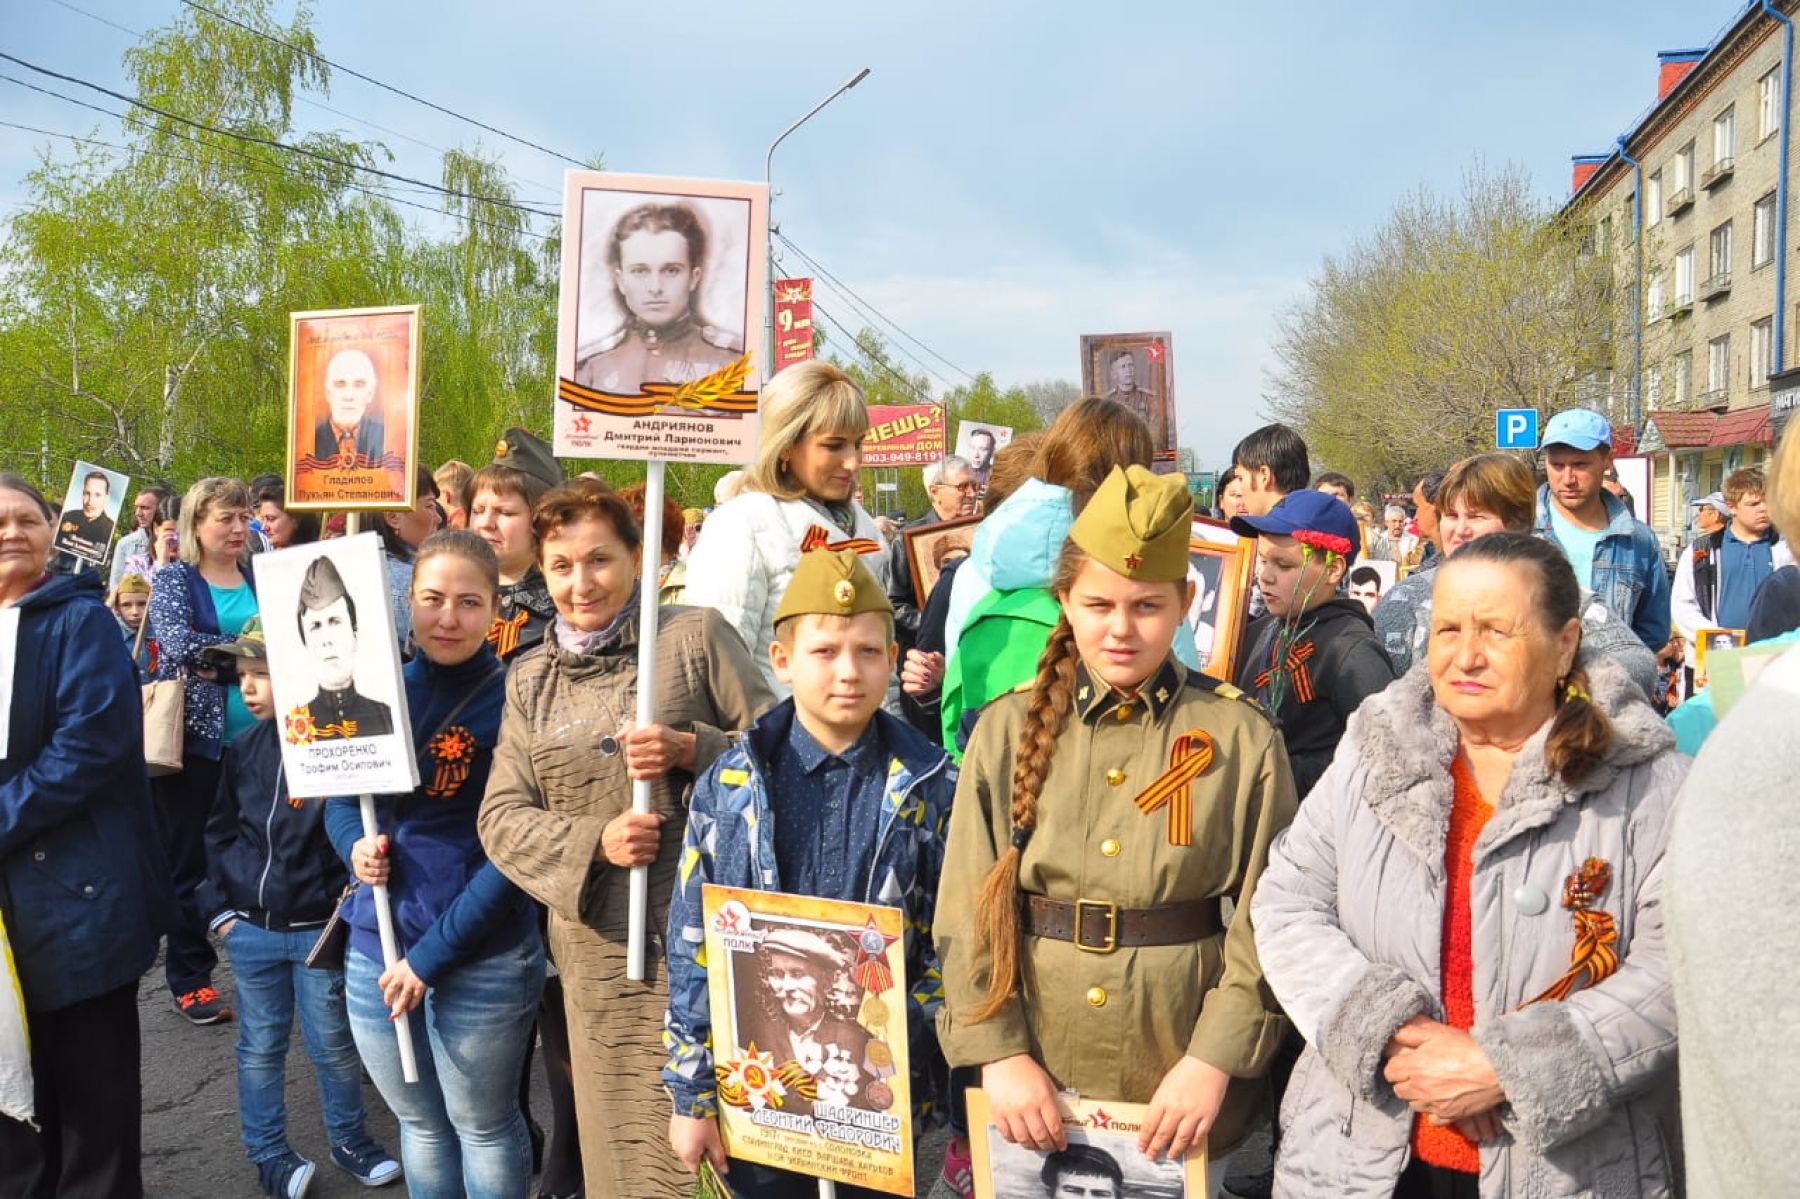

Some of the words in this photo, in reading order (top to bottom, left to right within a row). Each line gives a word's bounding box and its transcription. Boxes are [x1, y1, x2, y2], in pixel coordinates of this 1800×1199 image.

[778, 309, 792, 332] 9
[633, 420, 714, 433] АНДРИЯНОВ
[1507, 416, 1527, 443] P
[604, 431, 660, 443] Дмитрий
[664, 434, 742, 446] Ларионович
[323, 475, 374, 485] Гладилов
[337, 489, 400, 499] Степанович
[309, 743, 377, 759] ПРОХОРЕНКО
[300, 763, 339, 774] Трофим
[341, 760, 391, 772] Осипович
[753, 1109, 812, 1132] ЛЕОНТИЙ
[818, 1122, 900, 1150] ФЕДОРОВИЧ
